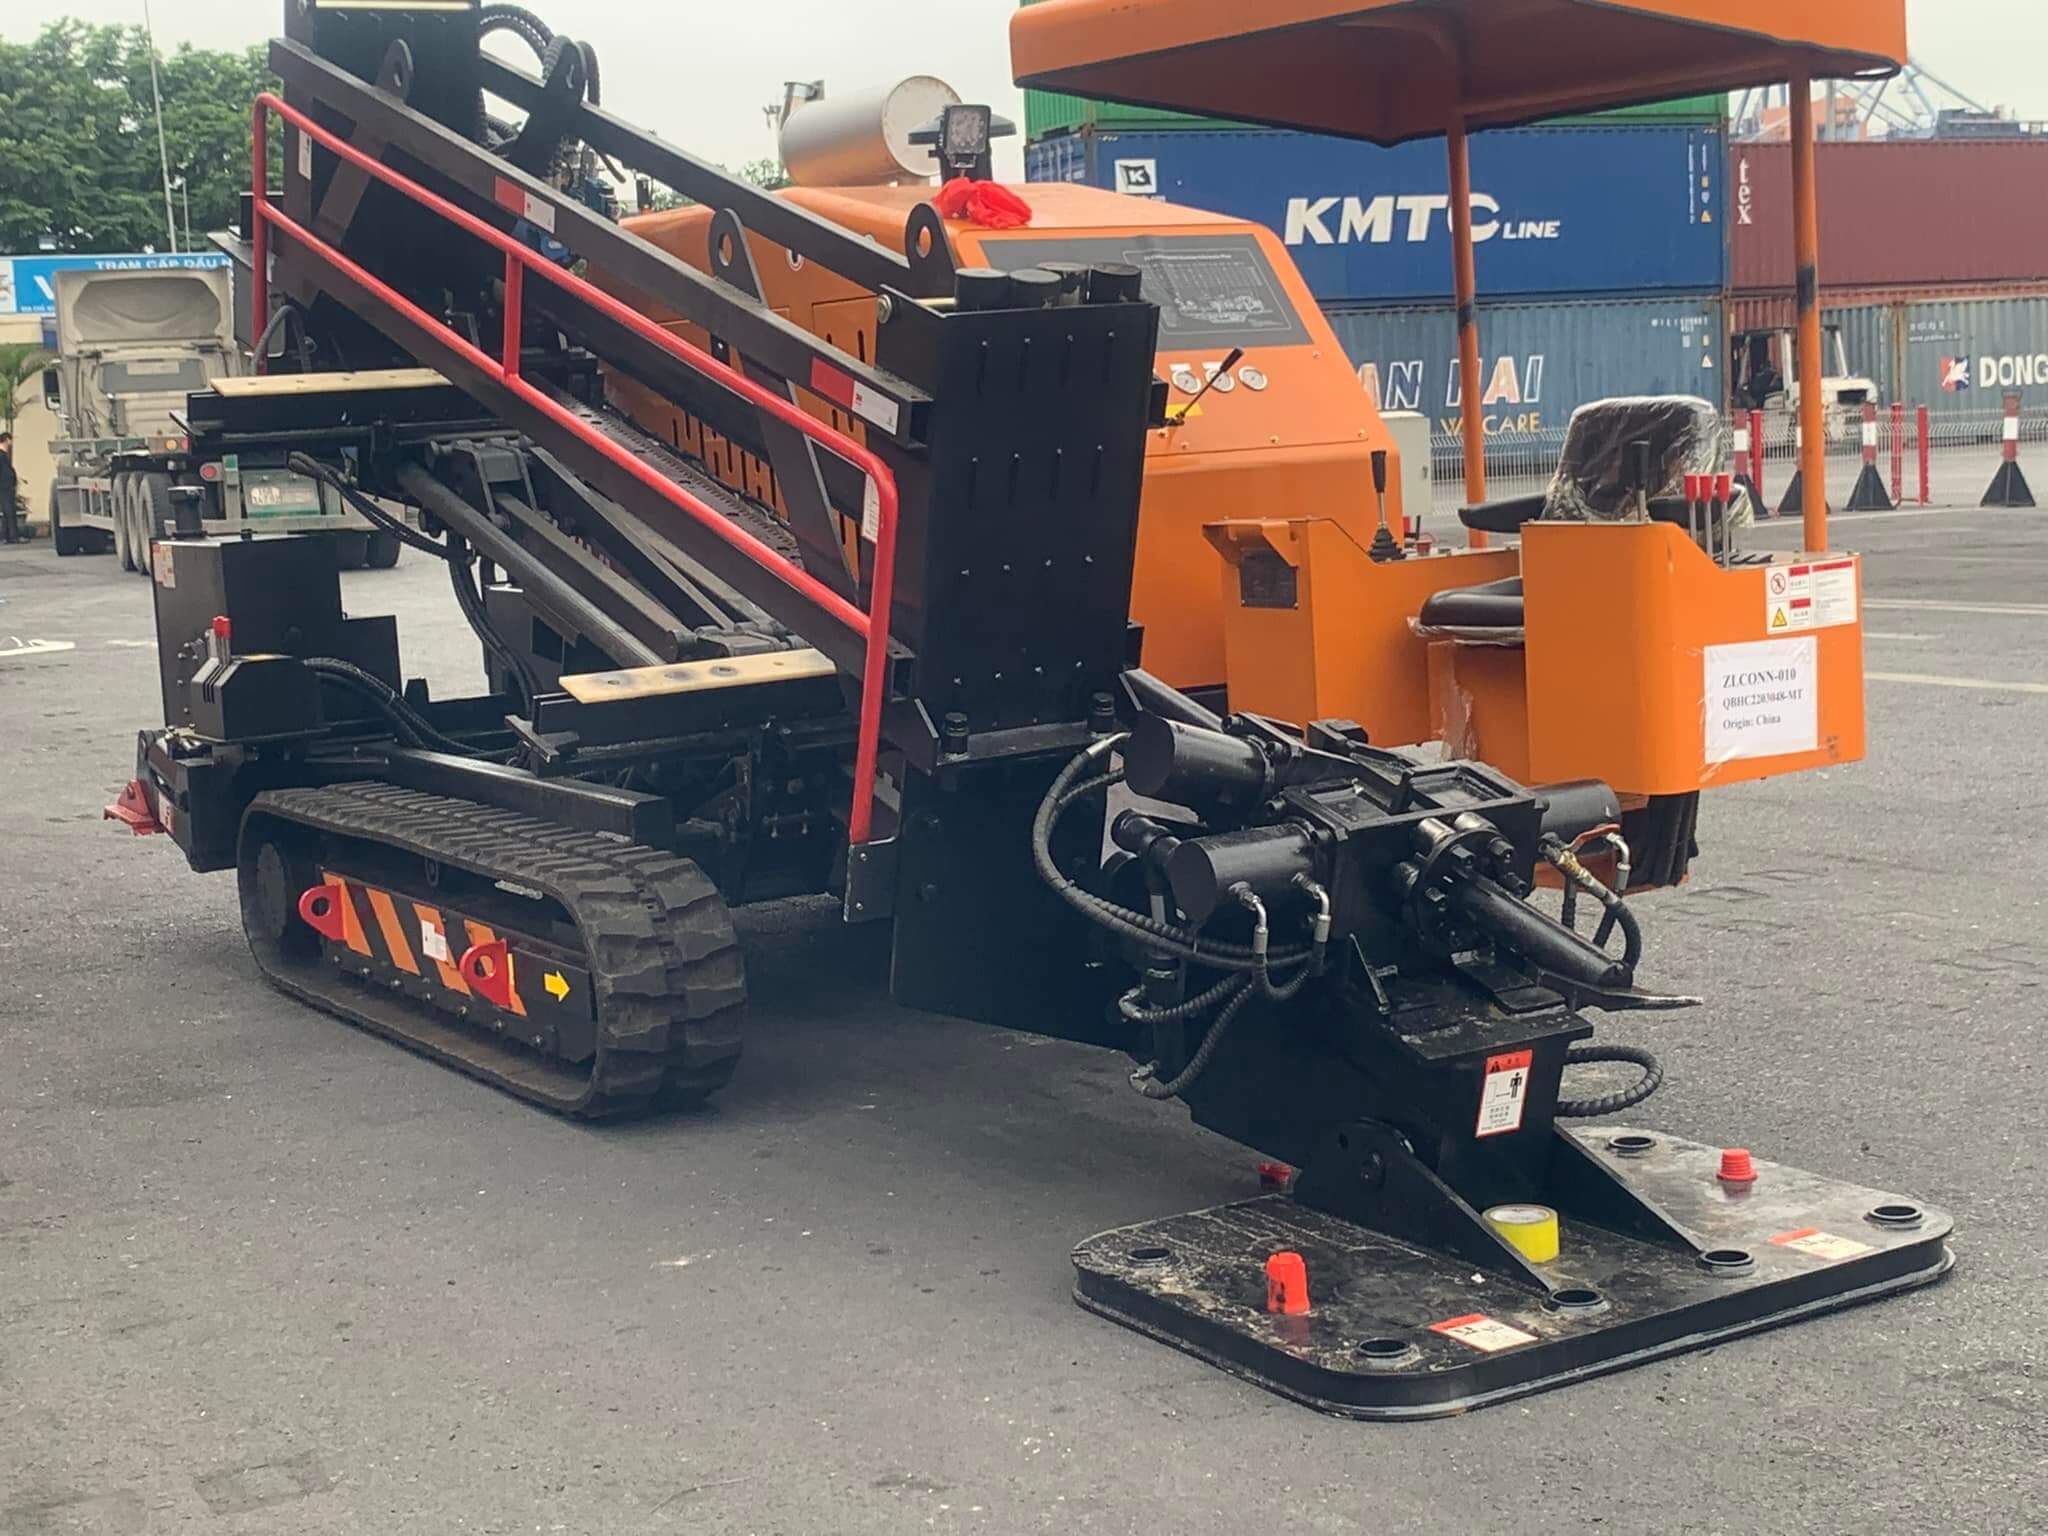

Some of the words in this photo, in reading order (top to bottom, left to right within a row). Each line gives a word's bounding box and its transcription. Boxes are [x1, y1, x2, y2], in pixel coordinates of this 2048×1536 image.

[1737, 157, 1752, 224] tex
[1284, 193, 1500, 245] KMTC
[1503, 220, 1560, 239] LINE
[1979, 354, 2048, 388] DONG
[1482, 412, 1541, 435] CARE
[1722, 668, 1797, 689] ZLCONN-010
[1723, 718, 1754, 730] Origin:
[1756, 713, 1781, 726] China
